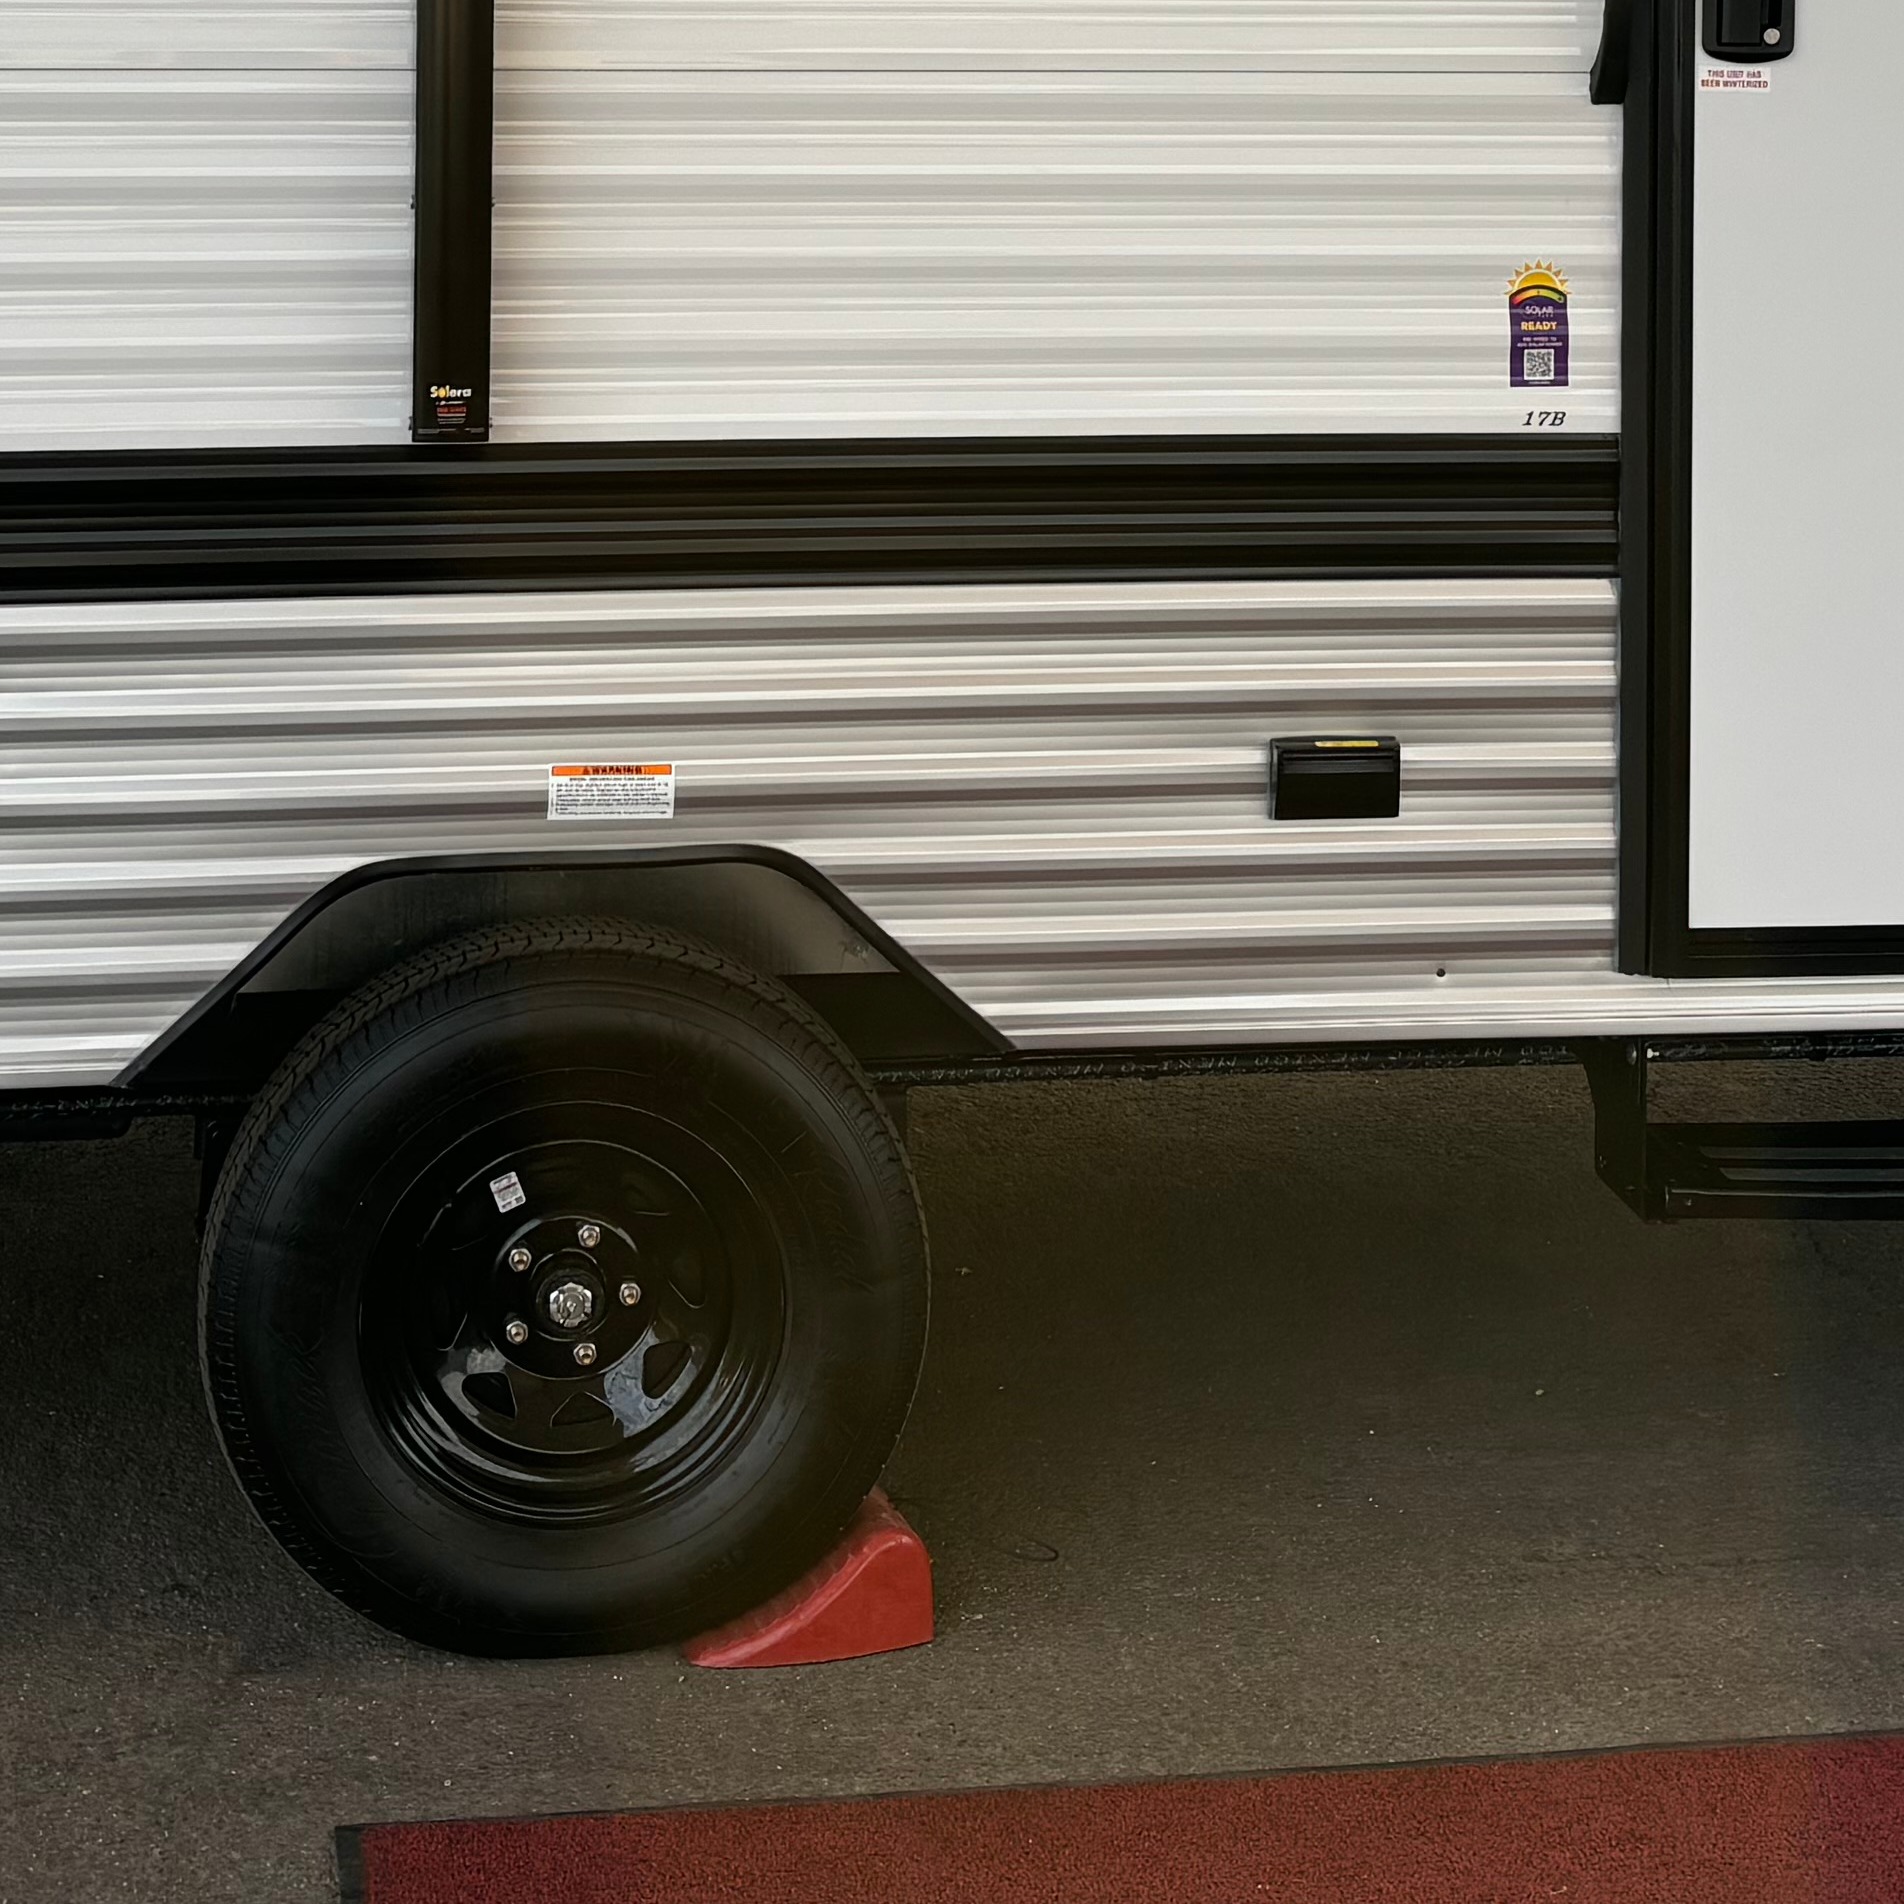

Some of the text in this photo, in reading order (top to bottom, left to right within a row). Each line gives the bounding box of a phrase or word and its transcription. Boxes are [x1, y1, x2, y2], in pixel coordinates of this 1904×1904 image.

[1524, 305, 1554, 315] SOLAR
[1520, 321, 1558, 331] READY
[1522, 411, 1567, 427] 17B
